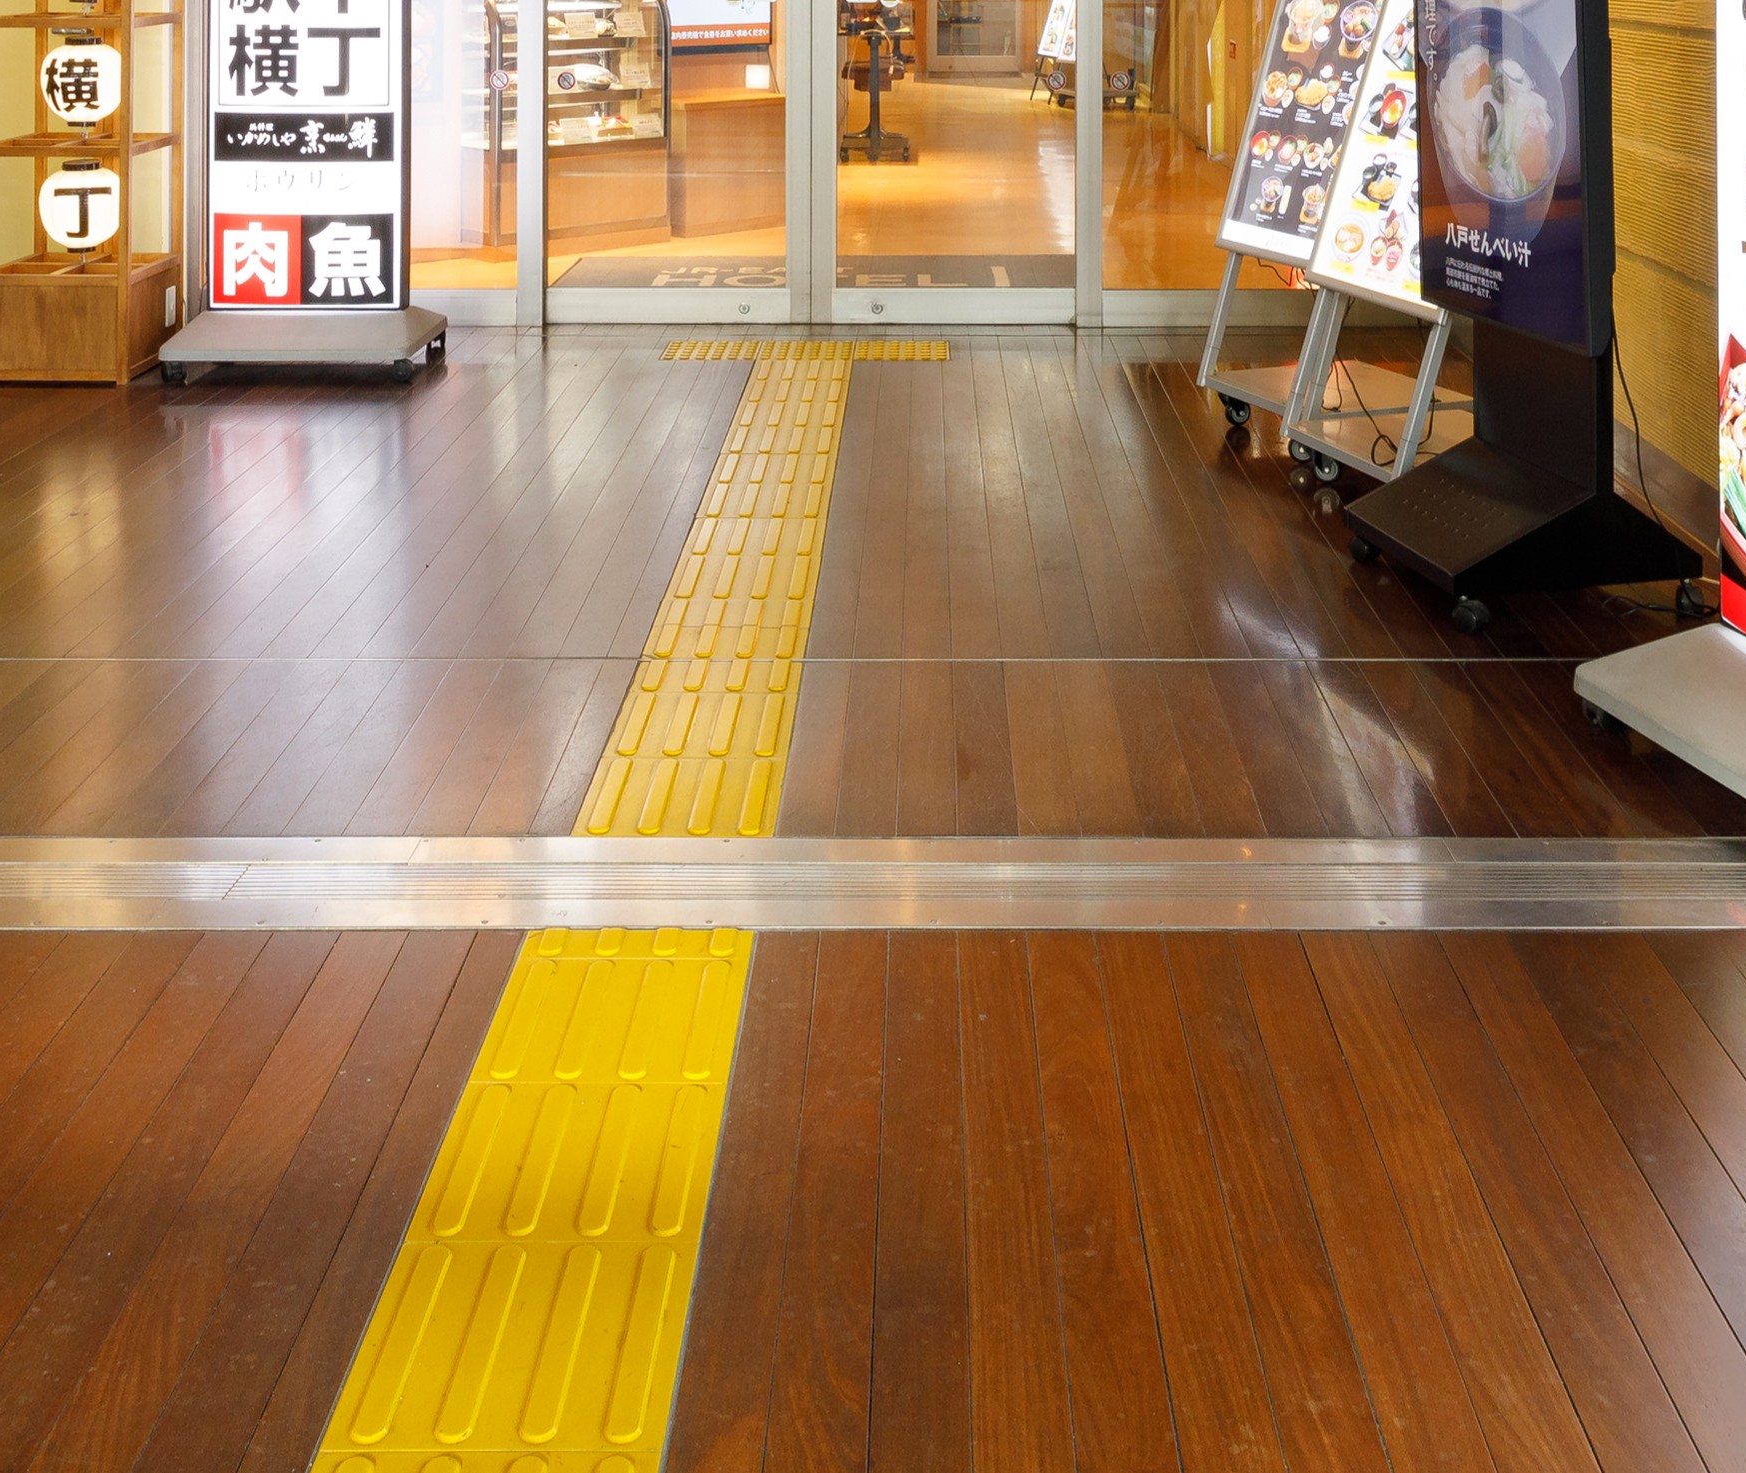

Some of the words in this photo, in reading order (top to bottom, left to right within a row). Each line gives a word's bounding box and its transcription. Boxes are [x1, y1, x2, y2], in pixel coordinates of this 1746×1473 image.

[228, 24, 381, 97] 横丁
[227, 132, 297, 147] いかめしや
[246, 169, 354, 193] ホウリン
[223, 221, 289, 297] 肉
[308, 221, 387, 298] 魚
[1444, 222, 1532, 268] 八戸せんべい汁
